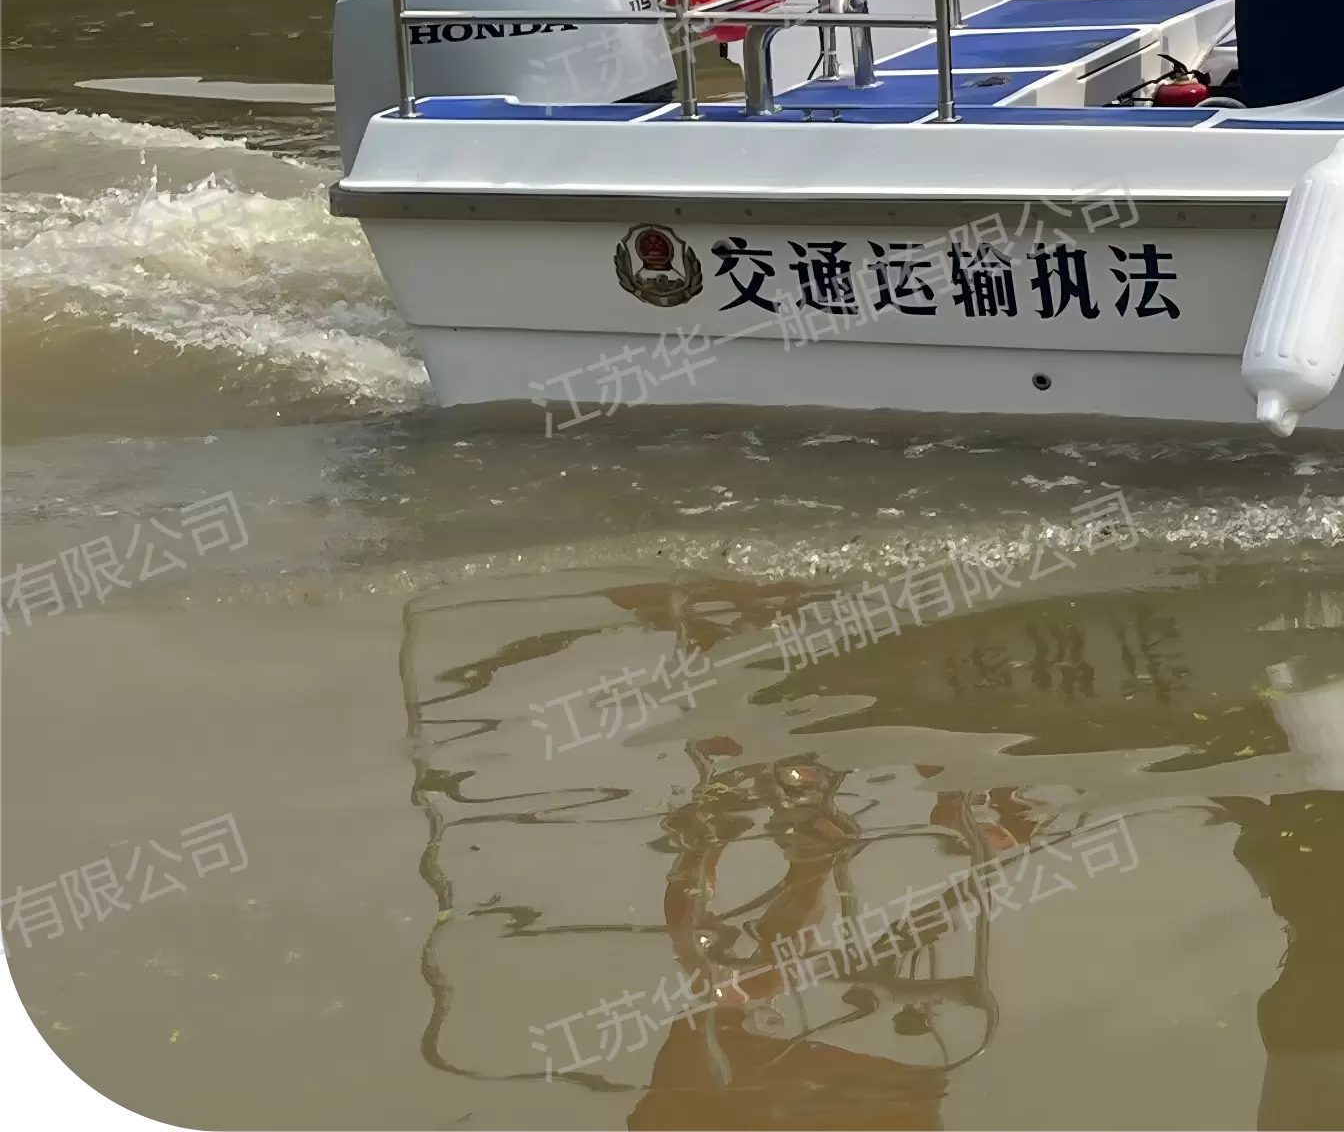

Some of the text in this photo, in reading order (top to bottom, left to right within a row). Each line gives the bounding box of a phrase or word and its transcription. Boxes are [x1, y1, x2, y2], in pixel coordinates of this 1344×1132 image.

[711, 236, 1181, 320] 交通运输执法
